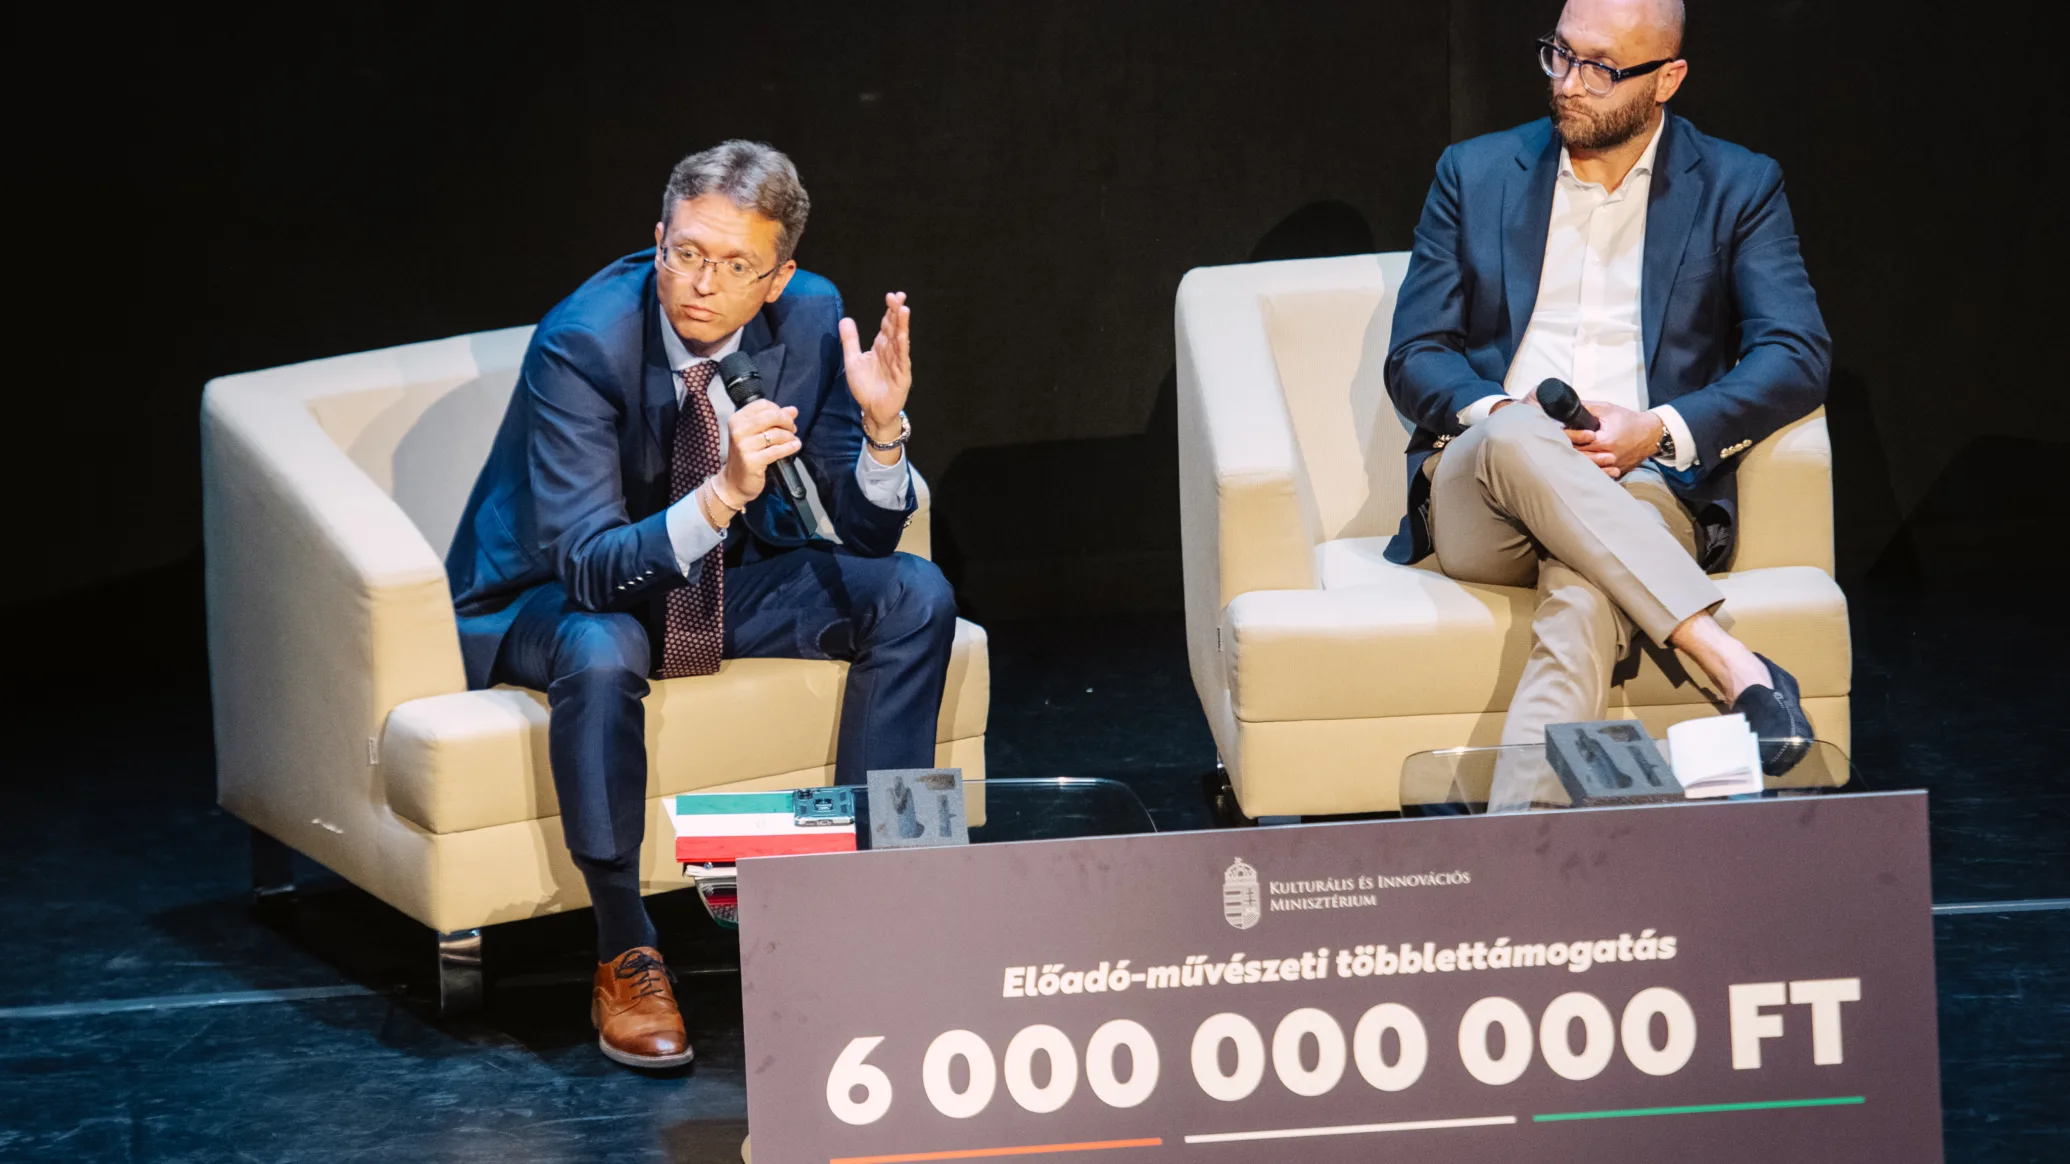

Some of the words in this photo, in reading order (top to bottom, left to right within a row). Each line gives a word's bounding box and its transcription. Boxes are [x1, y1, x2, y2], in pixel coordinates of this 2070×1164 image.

[1270, 893, 1377, 912] MINISZTÉRIUM
[1002, 947, 1331, 999] Előadó-művészeti
[1335, 928, 1678, 978] többlettámogatás
[825, 1035, 894, 1126] 6
[921, 1018, 1160, 1119] 000
[1190, 1002, 1428, 1102] 000
[1458, 986, 1697, 1086] 000
[1728, 978, 1862, 1070] FT
